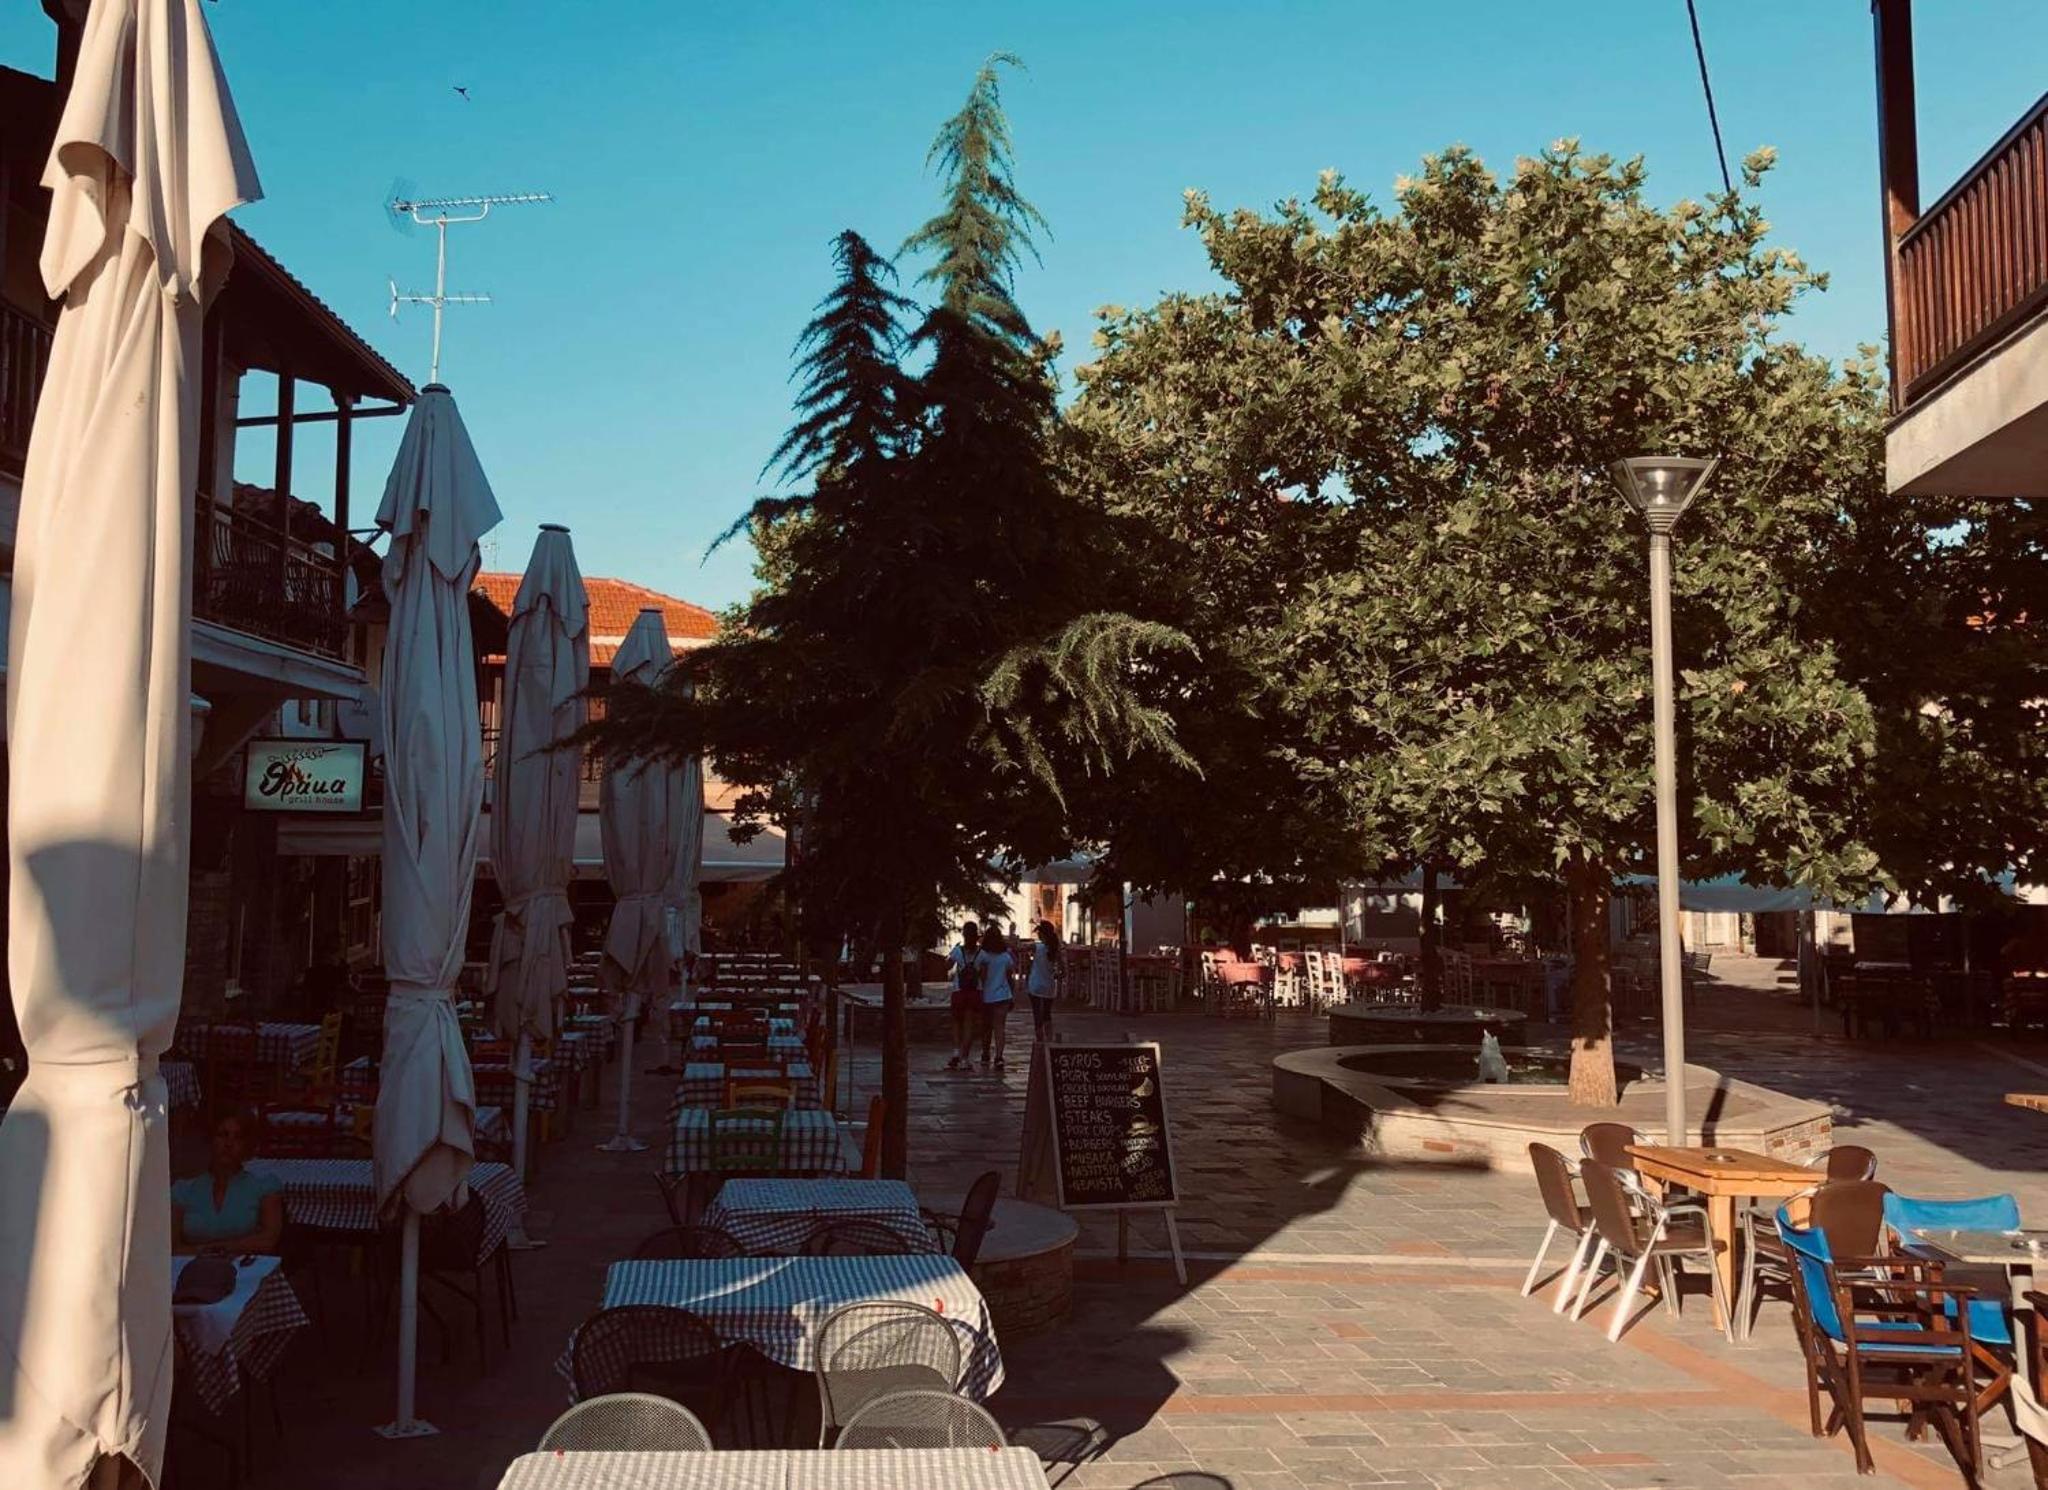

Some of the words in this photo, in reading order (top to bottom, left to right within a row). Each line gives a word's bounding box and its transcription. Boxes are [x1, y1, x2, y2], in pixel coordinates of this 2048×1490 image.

[1058, 1052, 1102, 1069] GYROS
[1061, 1070, 1090, 1082] PORK
[1063, 1096, 1090, 1109] BEEF
[1064, 1110, 1113, 1125] STEAKS
[1066, 1125, 1090, 1137] PORK
